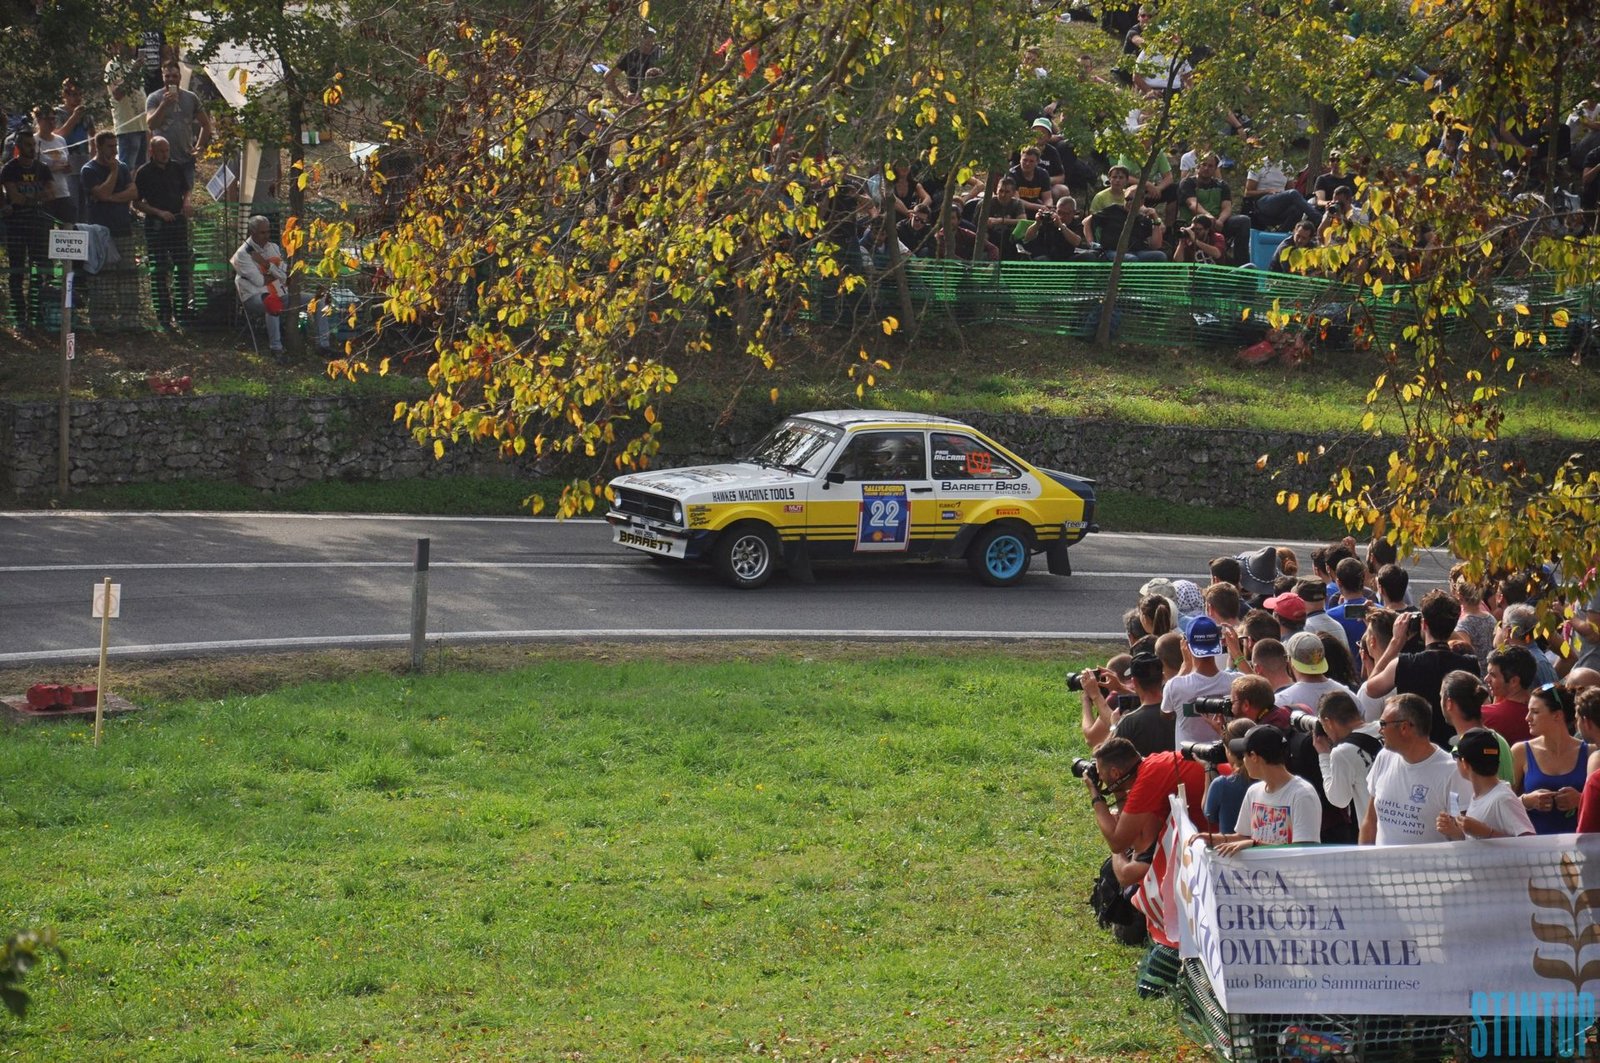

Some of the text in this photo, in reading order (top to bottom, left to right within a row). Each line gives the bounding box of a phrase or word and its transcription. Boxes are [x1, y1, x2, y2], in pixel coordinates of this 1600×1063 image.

[713, 488, 795, 502] HAWKES MACHINE TOOLS
[870, 500, 900, 527] 22
[619, 530, 673, 553] BARRETT
[1378, 806, 1419, 820] MAGNUM
[1403, 803, 1422, 813] EST
[1402, 828, 1424, 836] MMIV
[1214, 868, 1290, 896] ANCA
[1216, 903, 1346, 931] GRICOLA
[1219, 937, 1421, 967] OMMERCIALE
[1225, 973, 1421, 992] uto Bancario Sammarinese
